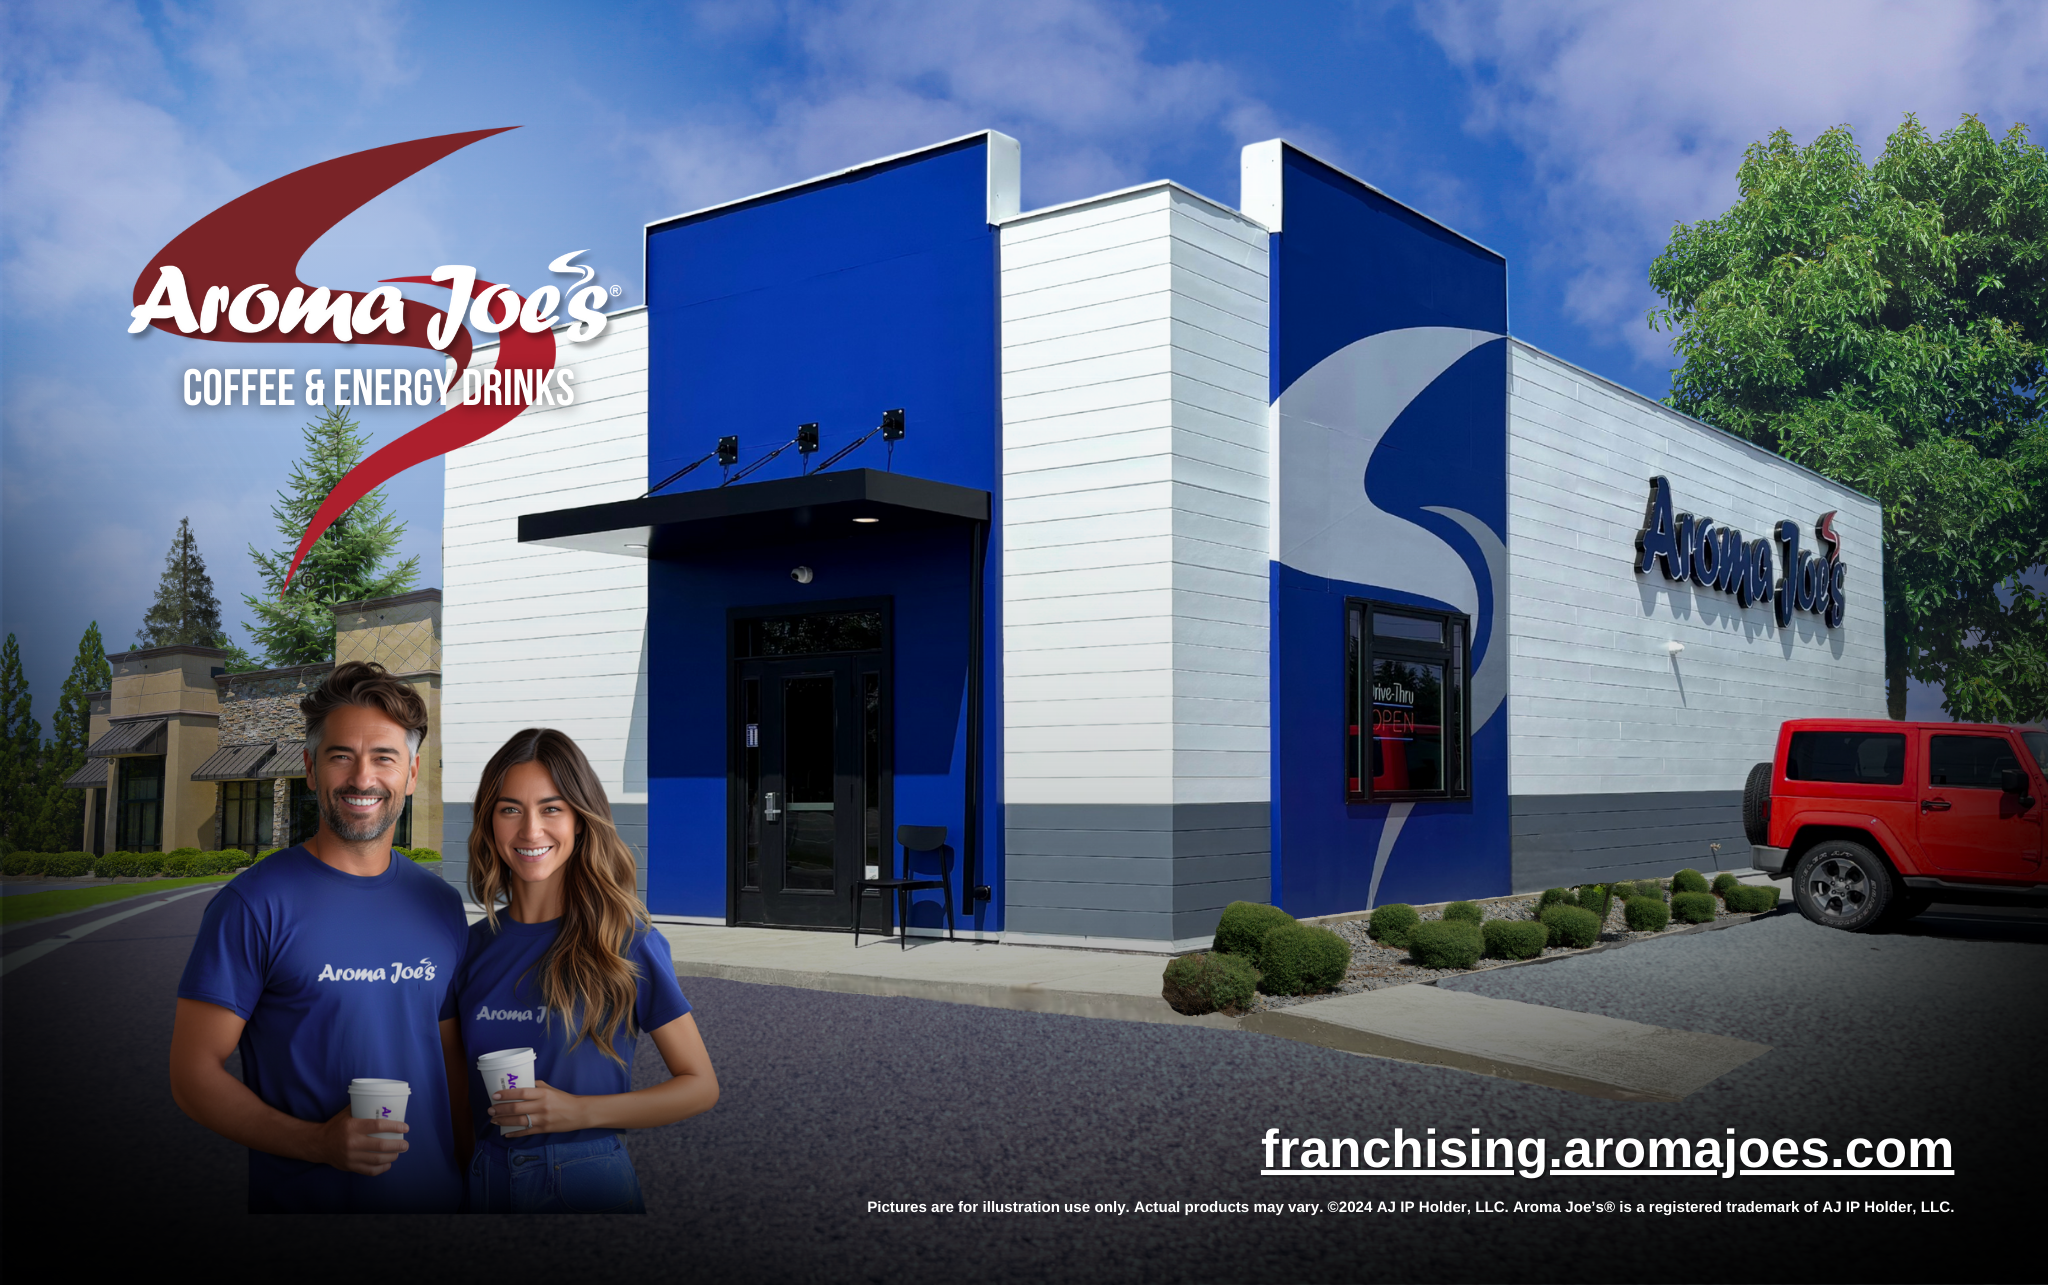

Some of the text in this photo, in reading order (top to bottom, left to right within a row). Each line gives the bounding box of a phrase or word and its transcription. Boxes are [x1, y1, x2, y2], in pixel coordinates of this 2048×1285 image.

[1634, 474, 1775, 609] Aroma
[1373, 682, 1414, 705] rive-Thru
[317, 963, 387, 983] Aroma
[476, 1005, 533, 1022] Aroma
